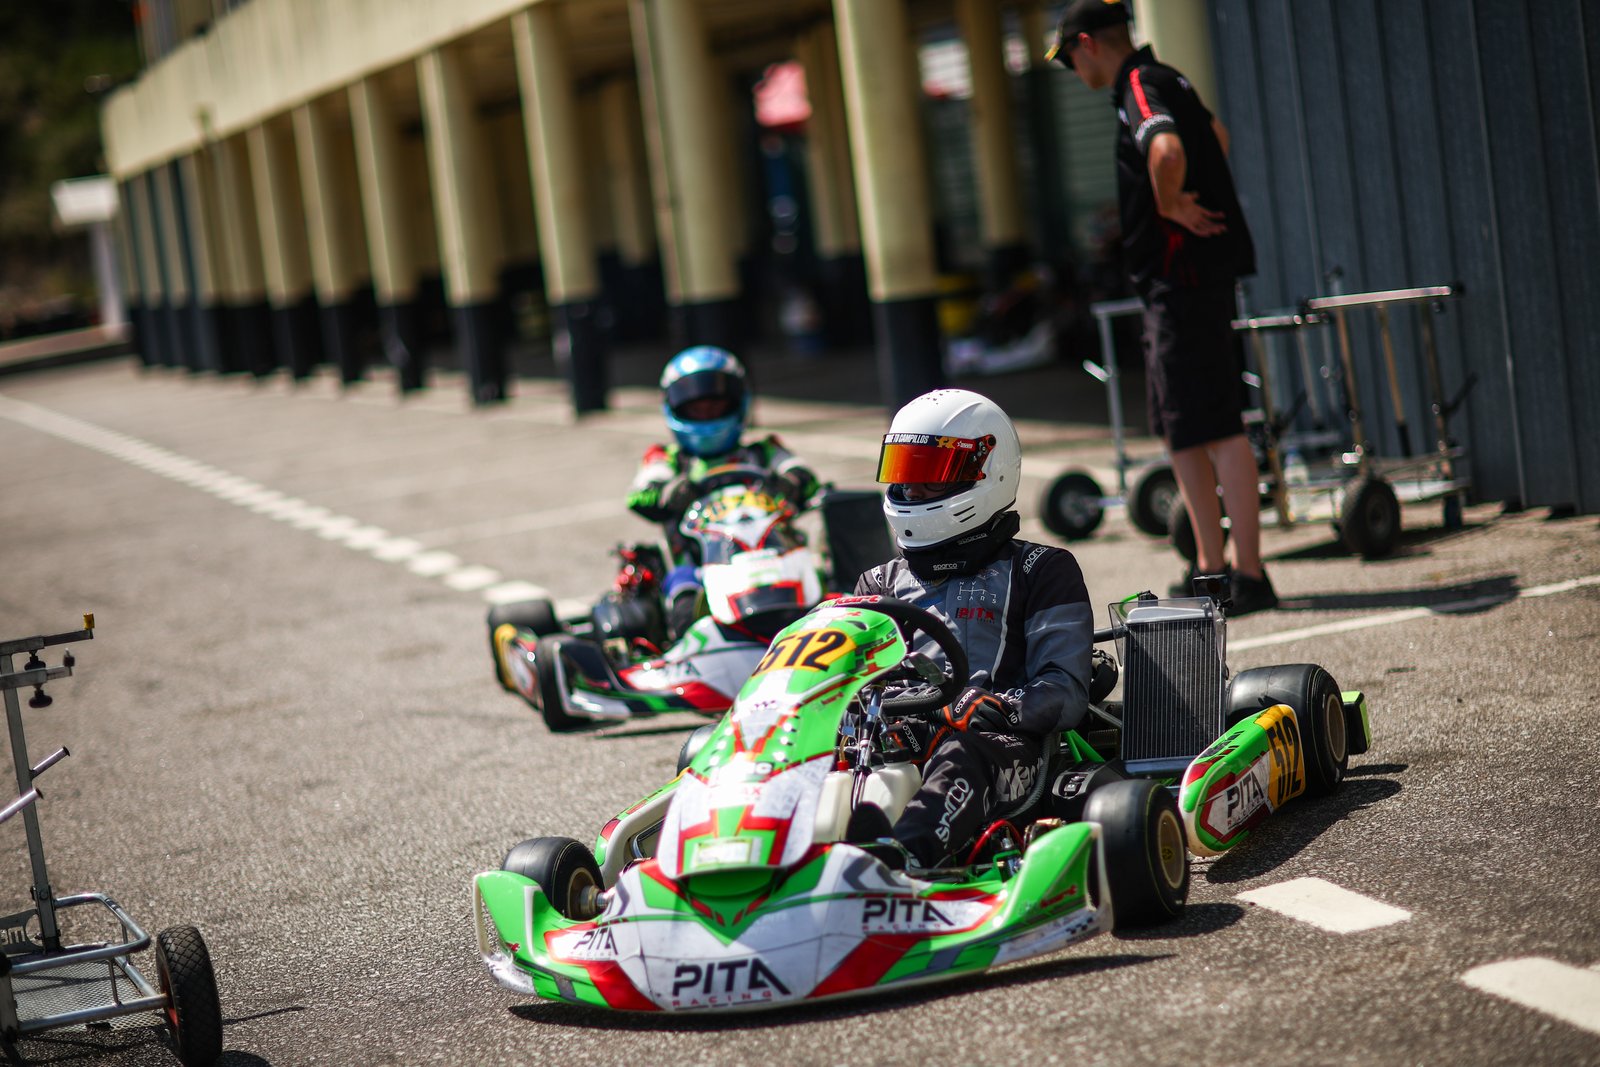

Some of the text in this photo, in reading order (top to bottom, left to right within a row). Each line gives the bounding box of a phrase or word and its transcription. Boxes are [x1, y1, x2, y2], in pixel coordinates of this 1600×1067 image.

[933, 563, 958, 572] sparco
[752, 629, 848, 677] 512
[902, 724, 922, 753] sparco
[1267, 715, 1303, 806] 512
[1227, 772, 1266, 819] PITA
[862, 899, 956, 927] PITA
[573, 926, 619, 956] PITA
[672, 957, 792, 997] PITA
[672, 990, 772, 1006] RACING
